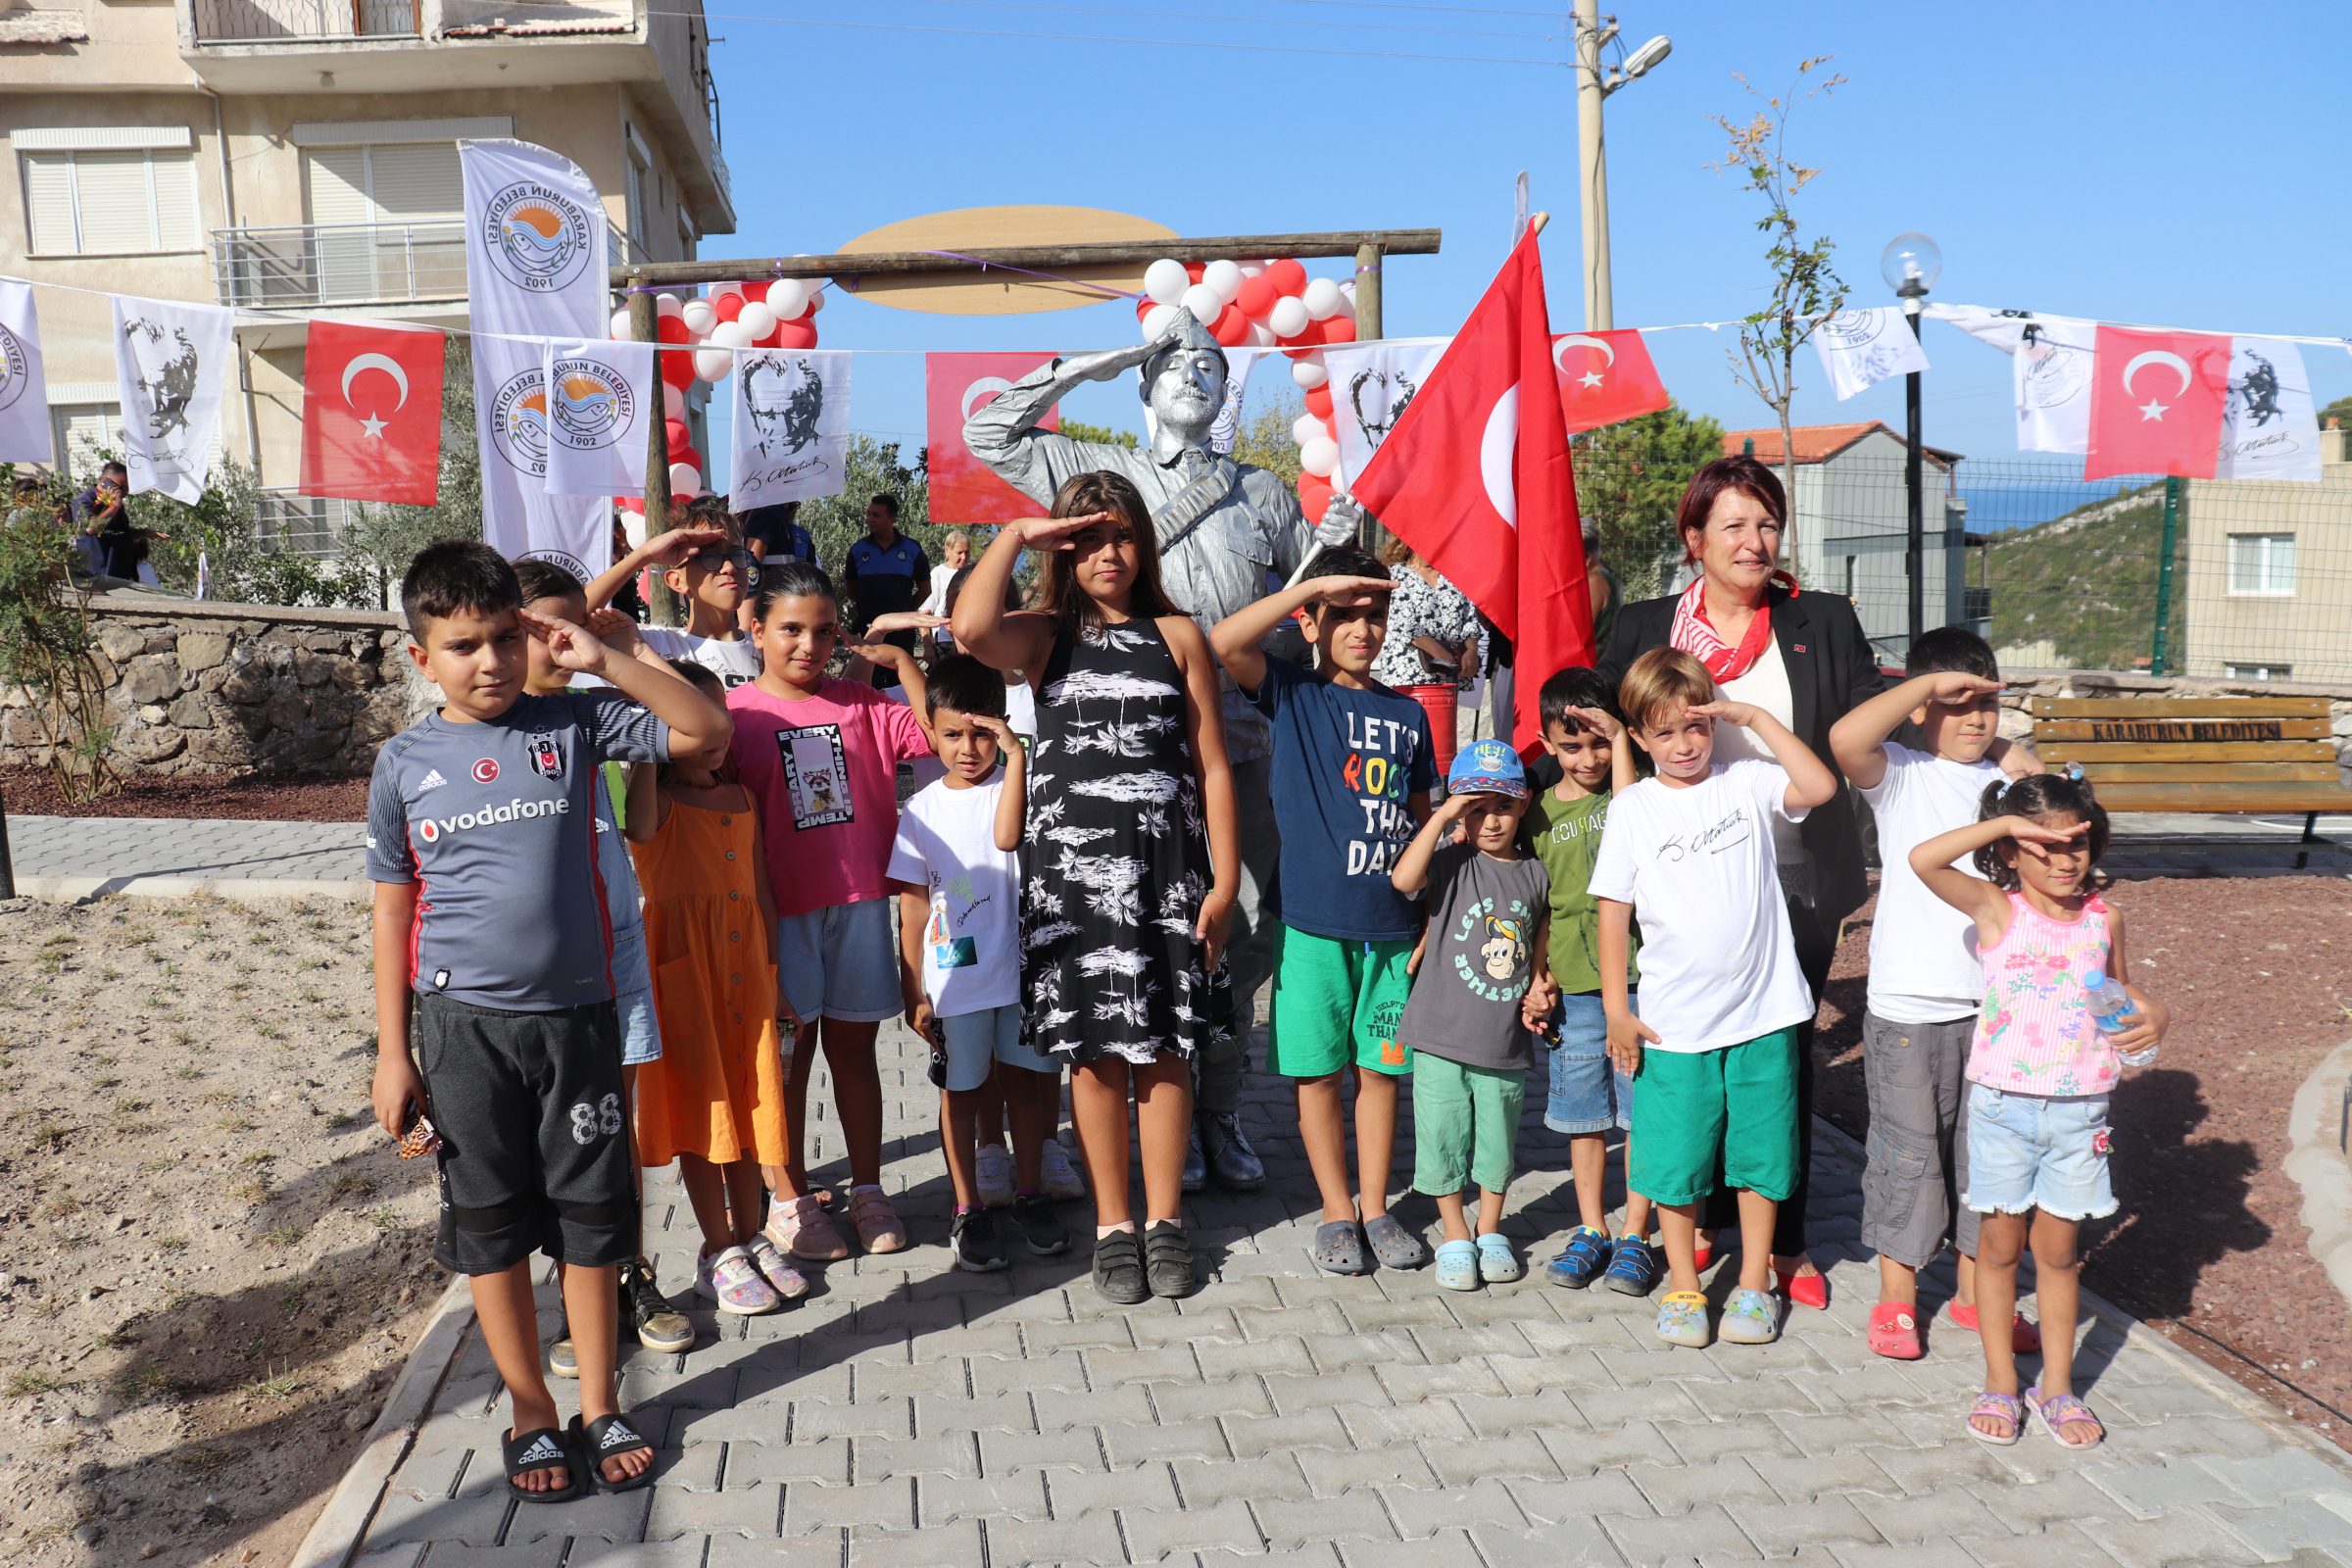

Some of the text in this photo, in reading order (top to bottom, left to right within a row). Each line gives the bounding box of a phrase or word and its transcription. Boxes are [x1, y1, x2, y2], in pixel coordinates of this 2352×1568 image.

[1847, 332, 1873, 345] 1902
[552, 361, 632, 417] BURUN BELEDİYESİ
[569, 435, 597, 447] 1902
[777, 724, 837, 742] EVERY
[1347, 711, 1419, 765] LET'S
[2091, 720, 2283, 742] KARABURUN BELEDİYESİ
[532, 741, 559, 754] BJK
[1473, 743, 1507, 757] HEY!
[831, 733, 849, 795] THING
[417, 778, 448, 792] adidas
[782, 750, 806, 820] ORARY
[438, 797, 570, 835] vodafone
[797, 810, 848, 829] TEMP
[1551, 810, 1607, 845] COURAG
[1454, 897, 1494, 942] LETS
[1454, 954, 1530, 1002] OGETHER
[1375, 1000, 1405, 1012] HELPFU
[1372, 1010, 1402, 1026] MAN
[1366, 1024, 1397, 1041] THAN
[569, 1092, 621, 1146] 88
[600, 1433, 641, 1449] adidas
[517, 1448, 564, 1465] adidas
